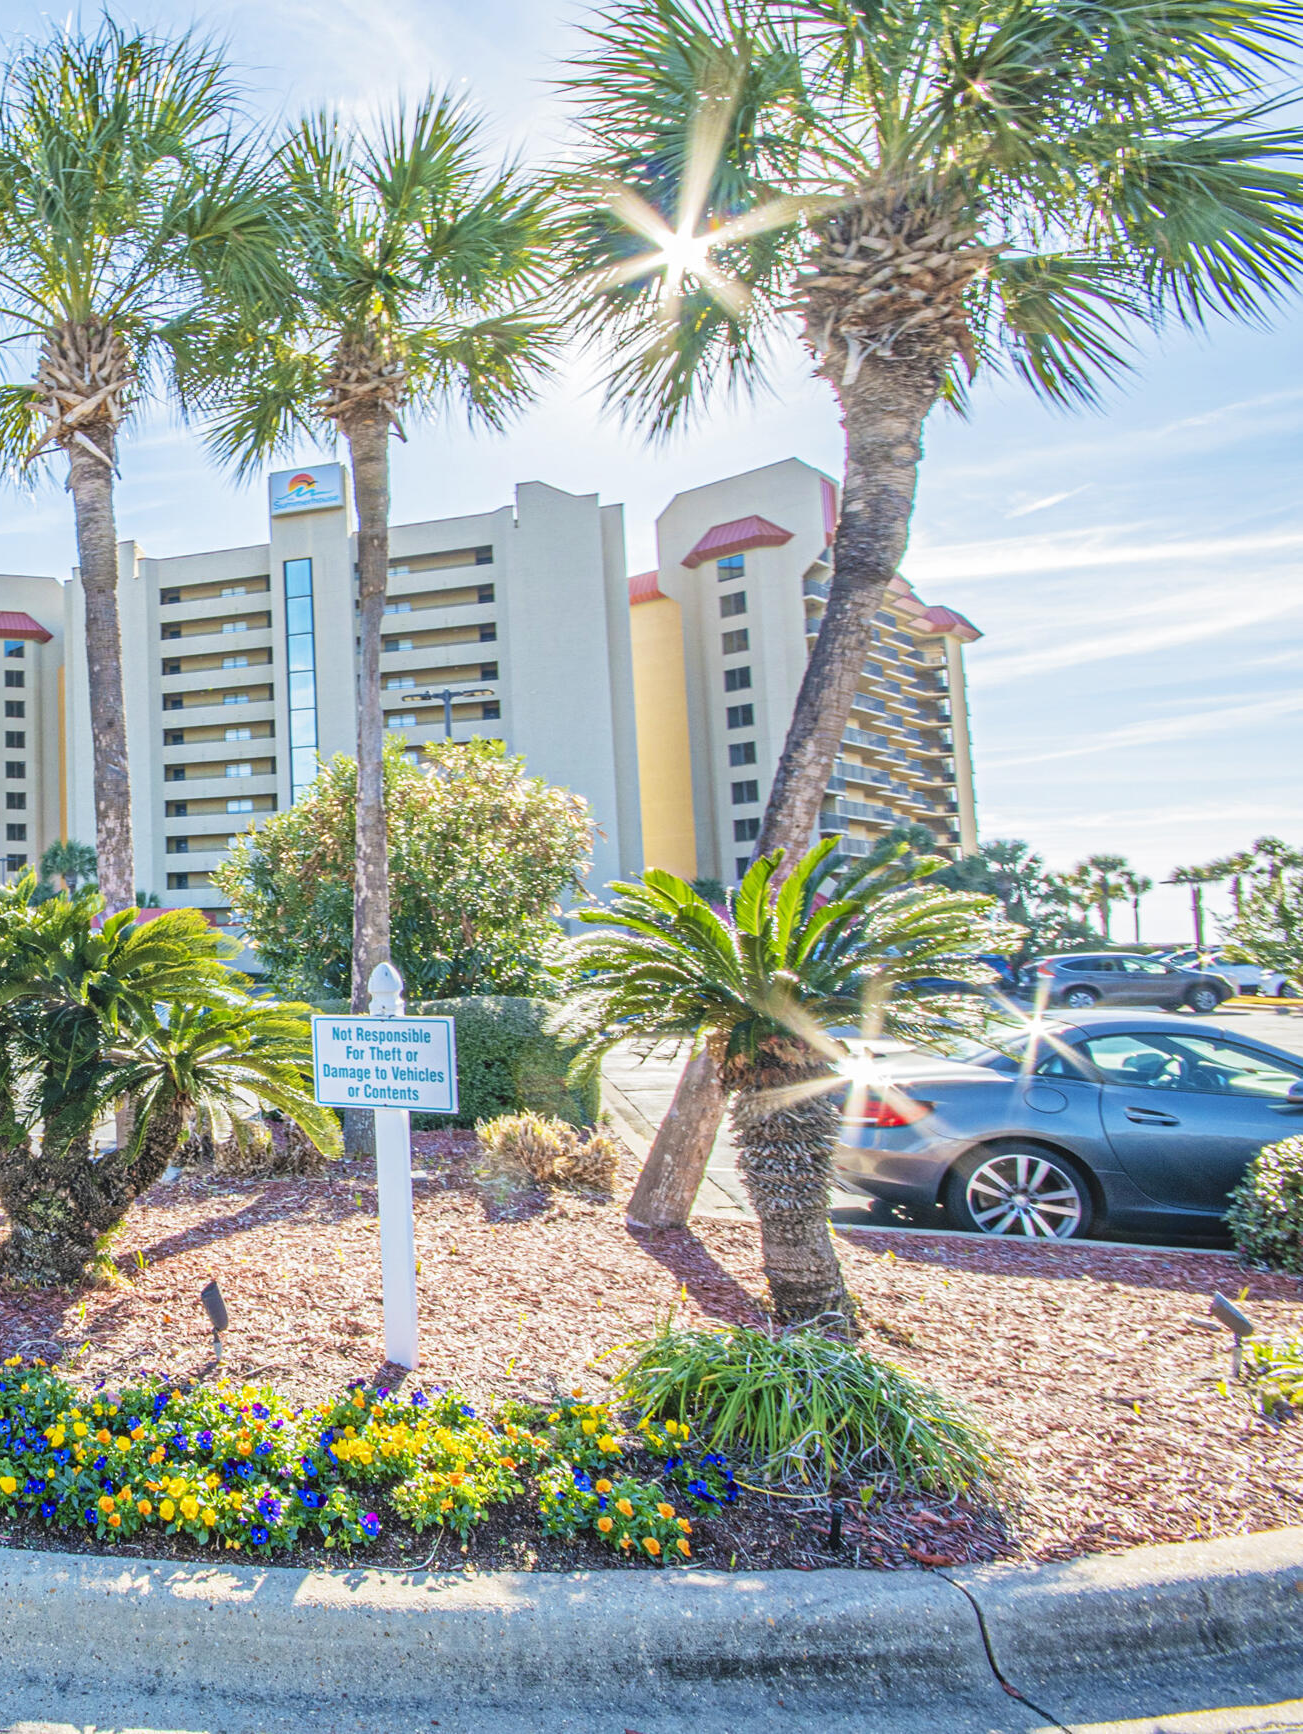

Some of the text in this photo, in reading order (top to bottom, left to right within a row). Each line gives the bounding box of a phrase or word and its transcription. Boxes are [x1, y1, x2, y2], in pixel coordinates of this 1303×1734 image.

[332, 1027, 431, 1045] Not Responsible
[346, 1046, 418, 1062] For Theft or
[323, 1064, 444, 1083] Damage to Vehicles
[348, 1084, 419, 1101] or Contents
